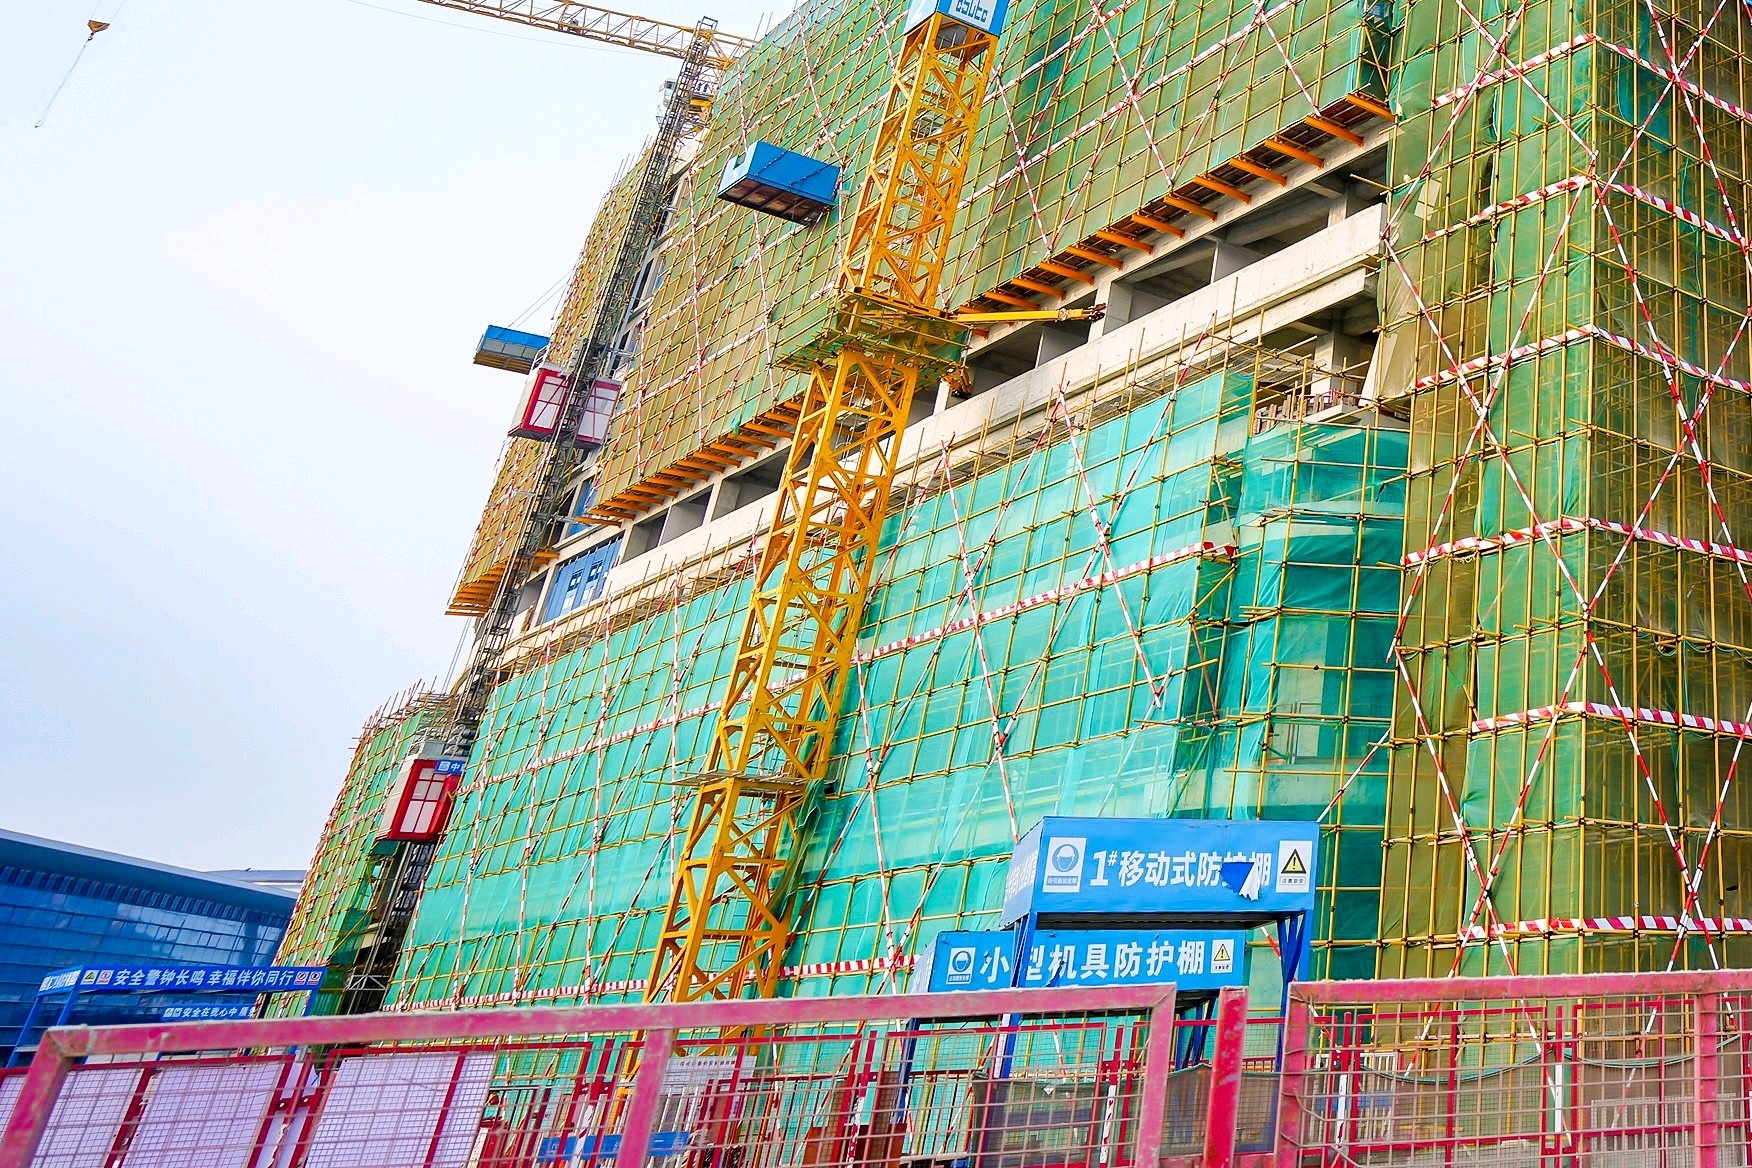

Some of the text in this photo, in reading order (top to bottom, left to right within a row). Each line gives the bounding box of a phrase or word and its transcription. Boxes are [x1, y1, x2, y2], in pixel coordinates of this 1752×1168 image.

[113, 969, 295, 987] 安全警钟长鸣 幸福伴你同行
